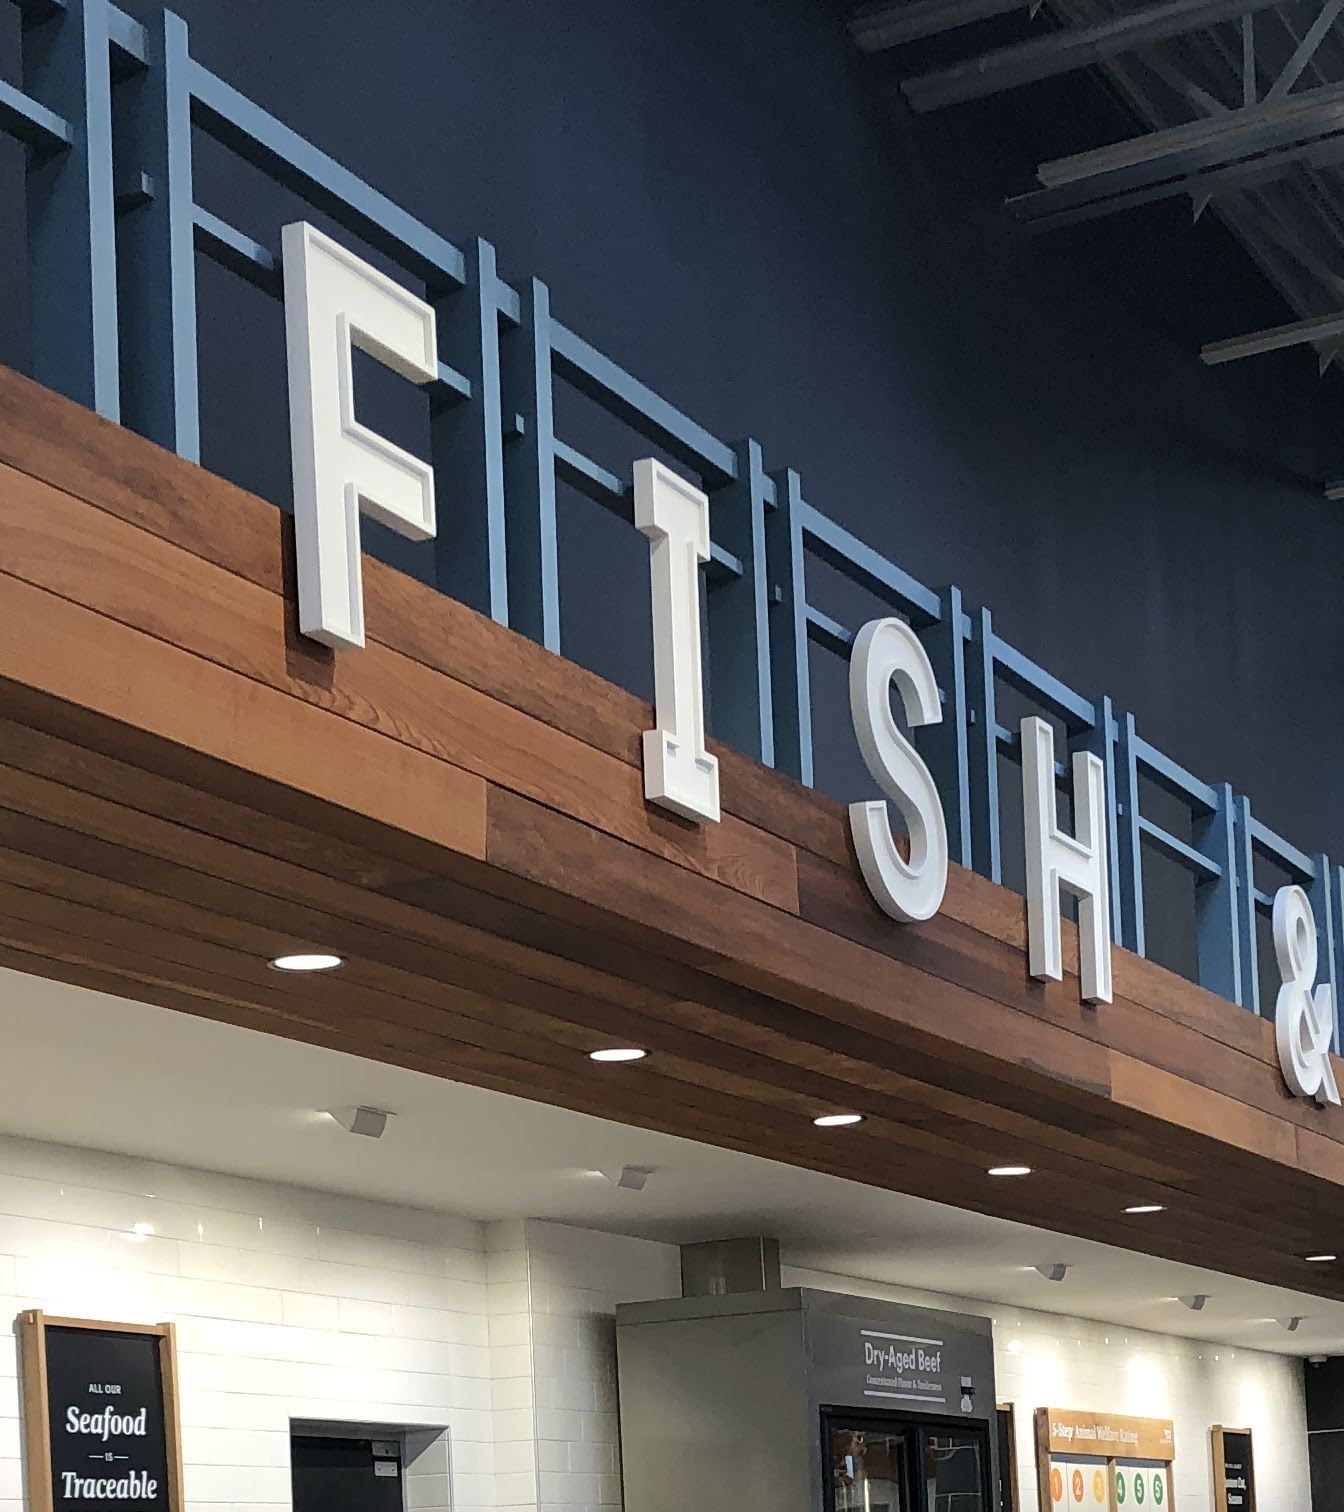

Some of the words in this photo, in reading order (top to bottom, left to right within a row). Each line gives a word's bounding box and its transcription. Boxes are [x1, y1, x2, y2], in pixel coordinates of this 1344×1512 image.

[282, 221, 1112, 1004] FISH
[1273, 884, 1341, 1107] &
[864, 1342, 916, 1374] Dry-Aged
[917, 1349, 941, 1372] Beef
[89, 1384, 103, 1394] ALL
[105, 1385, 121, 1394] OUR
[65, 1405, 147, 1441] Seafood
[104, 1452, 113, 1461] IS
[61, 1470, 158, 1499] Traceable
[1075, 1476, 1081, 1495] 2
[1135, 1479, 1142, 1498] 5
